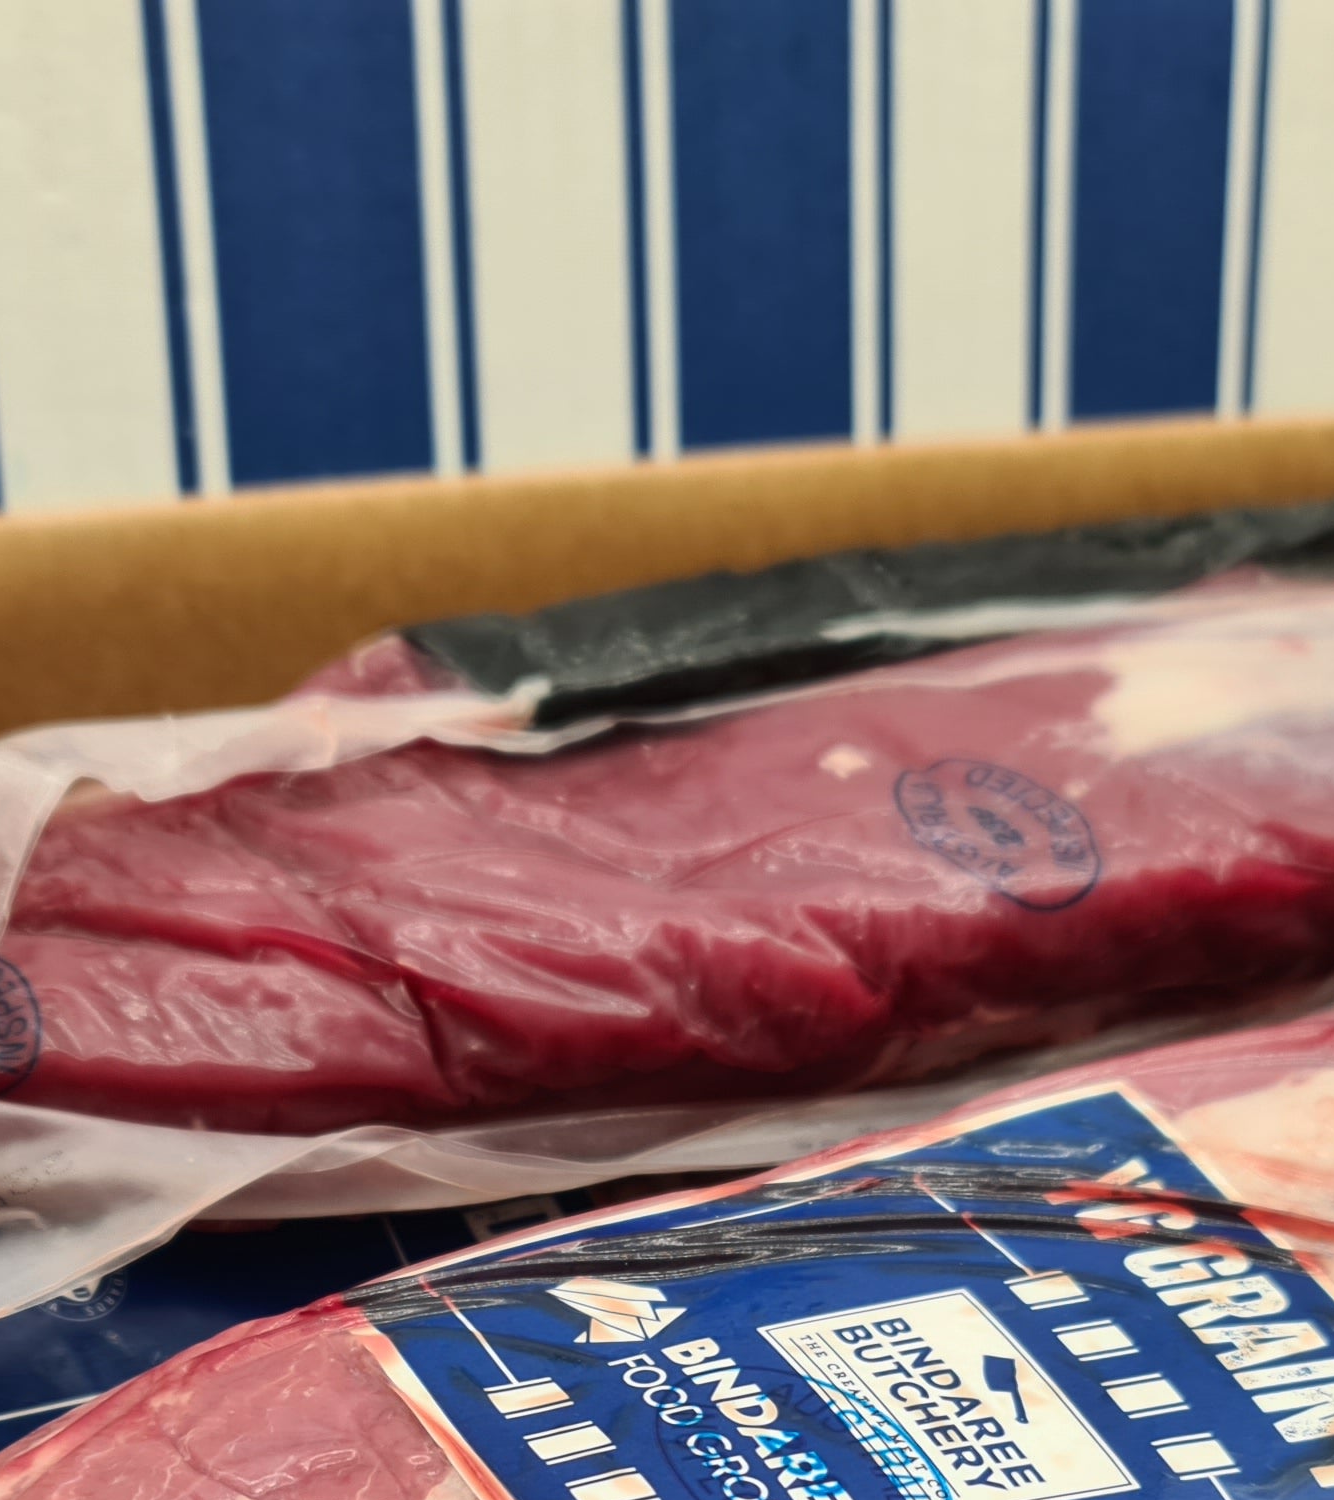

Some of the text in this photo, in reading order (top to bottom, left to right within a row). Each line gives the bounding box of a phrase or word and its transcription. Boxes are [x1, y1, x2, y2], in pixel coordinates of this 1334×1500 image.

[607, 1353, 705, 1427] FOOD
[798, 1334, 950, 1500] THE CREATIVE MEAT CO
[833, 1324, 1008, 1491] BUTCHERY
[872, 1318, 1046, 1489] BINDAREE
